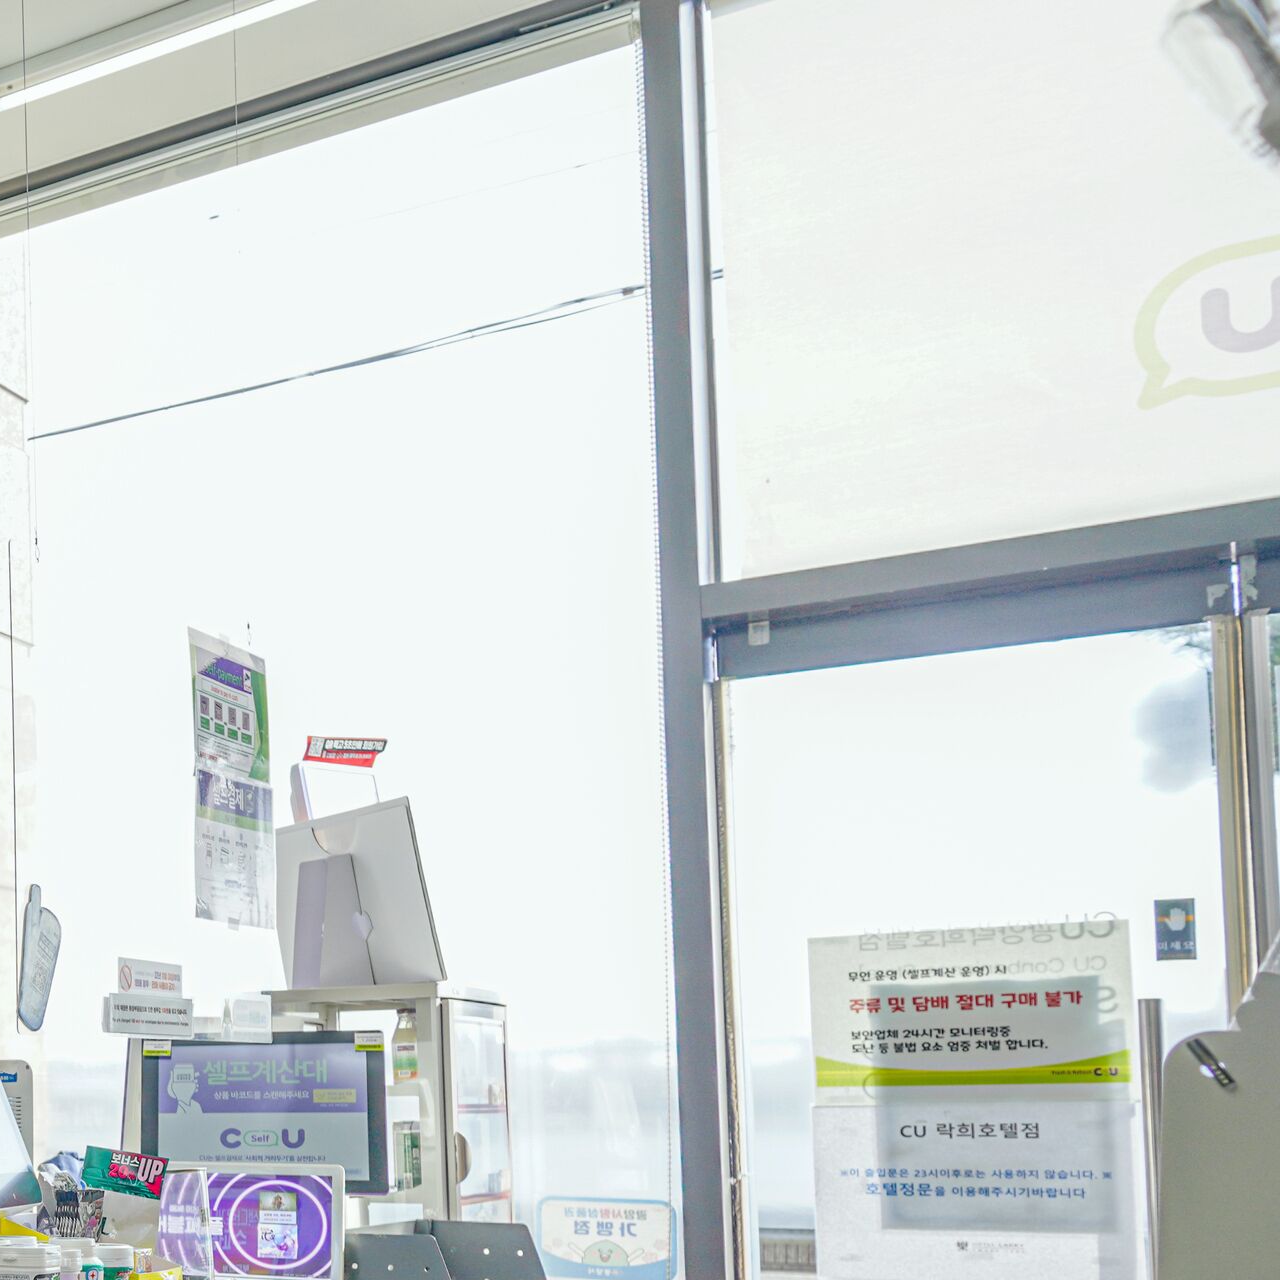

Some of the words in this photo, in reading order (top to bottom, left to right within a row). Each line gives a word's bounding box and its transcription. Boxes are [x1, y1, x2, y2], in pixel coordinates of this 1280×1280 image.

[875, 969, 898, 981] 운영
[902, 966, 956, 981] (셀프계산
[960, 964, 990, 979] 운영)
[994, 964, 1007, 975] 시
[849, 998, 881, 1014] 주류
[888, 996, 906, 1013] 및
[912, 994, 949, 1011] 담배
[956, 993, 994, 1011] 절대
[1001, 992, 1038, 1009] 구매
[1044, 989, 1082, 1008] 불가
[851, 1028, 899, 1041] 보안업체
[902, 1027, 945, 1039] 24시간
[949, 1026, 1011, 1038] 모니터링중
[852, 1041, 874, 1054] 도난
[893, 1041, 918, 1053] 불법
[921, 1040, 943, 1052] 요소
[948, 1039, 971, 1052] 엄중
[975, 1038, 1001, 1051] 처벌
[1005, 1037, 1049, 1050] 합니다.
[202, 1058, 328, 1086] 셀프계산대
[214, 1090, 229, 1100] 상품
[263, 1090, 310, 1100] 스캔해주세요
[250, 1134, 270, 1144] Self
[899, 1124, 927, 1139] CU
[936, 1121, 1041, 1141] 락희호텔점
[110, 1151, 140, 1167] 보너스
[138, 1156, 164, 1184] UP
[991, 1168, 1039, 1180] 사용하지
[1044, 1168, 1098, 1180] 않습니다.
[865, 1181, 946, 1198] 호텔정문을
[952, 1186, 1086, 1199] 이용해주시기바랍니다
